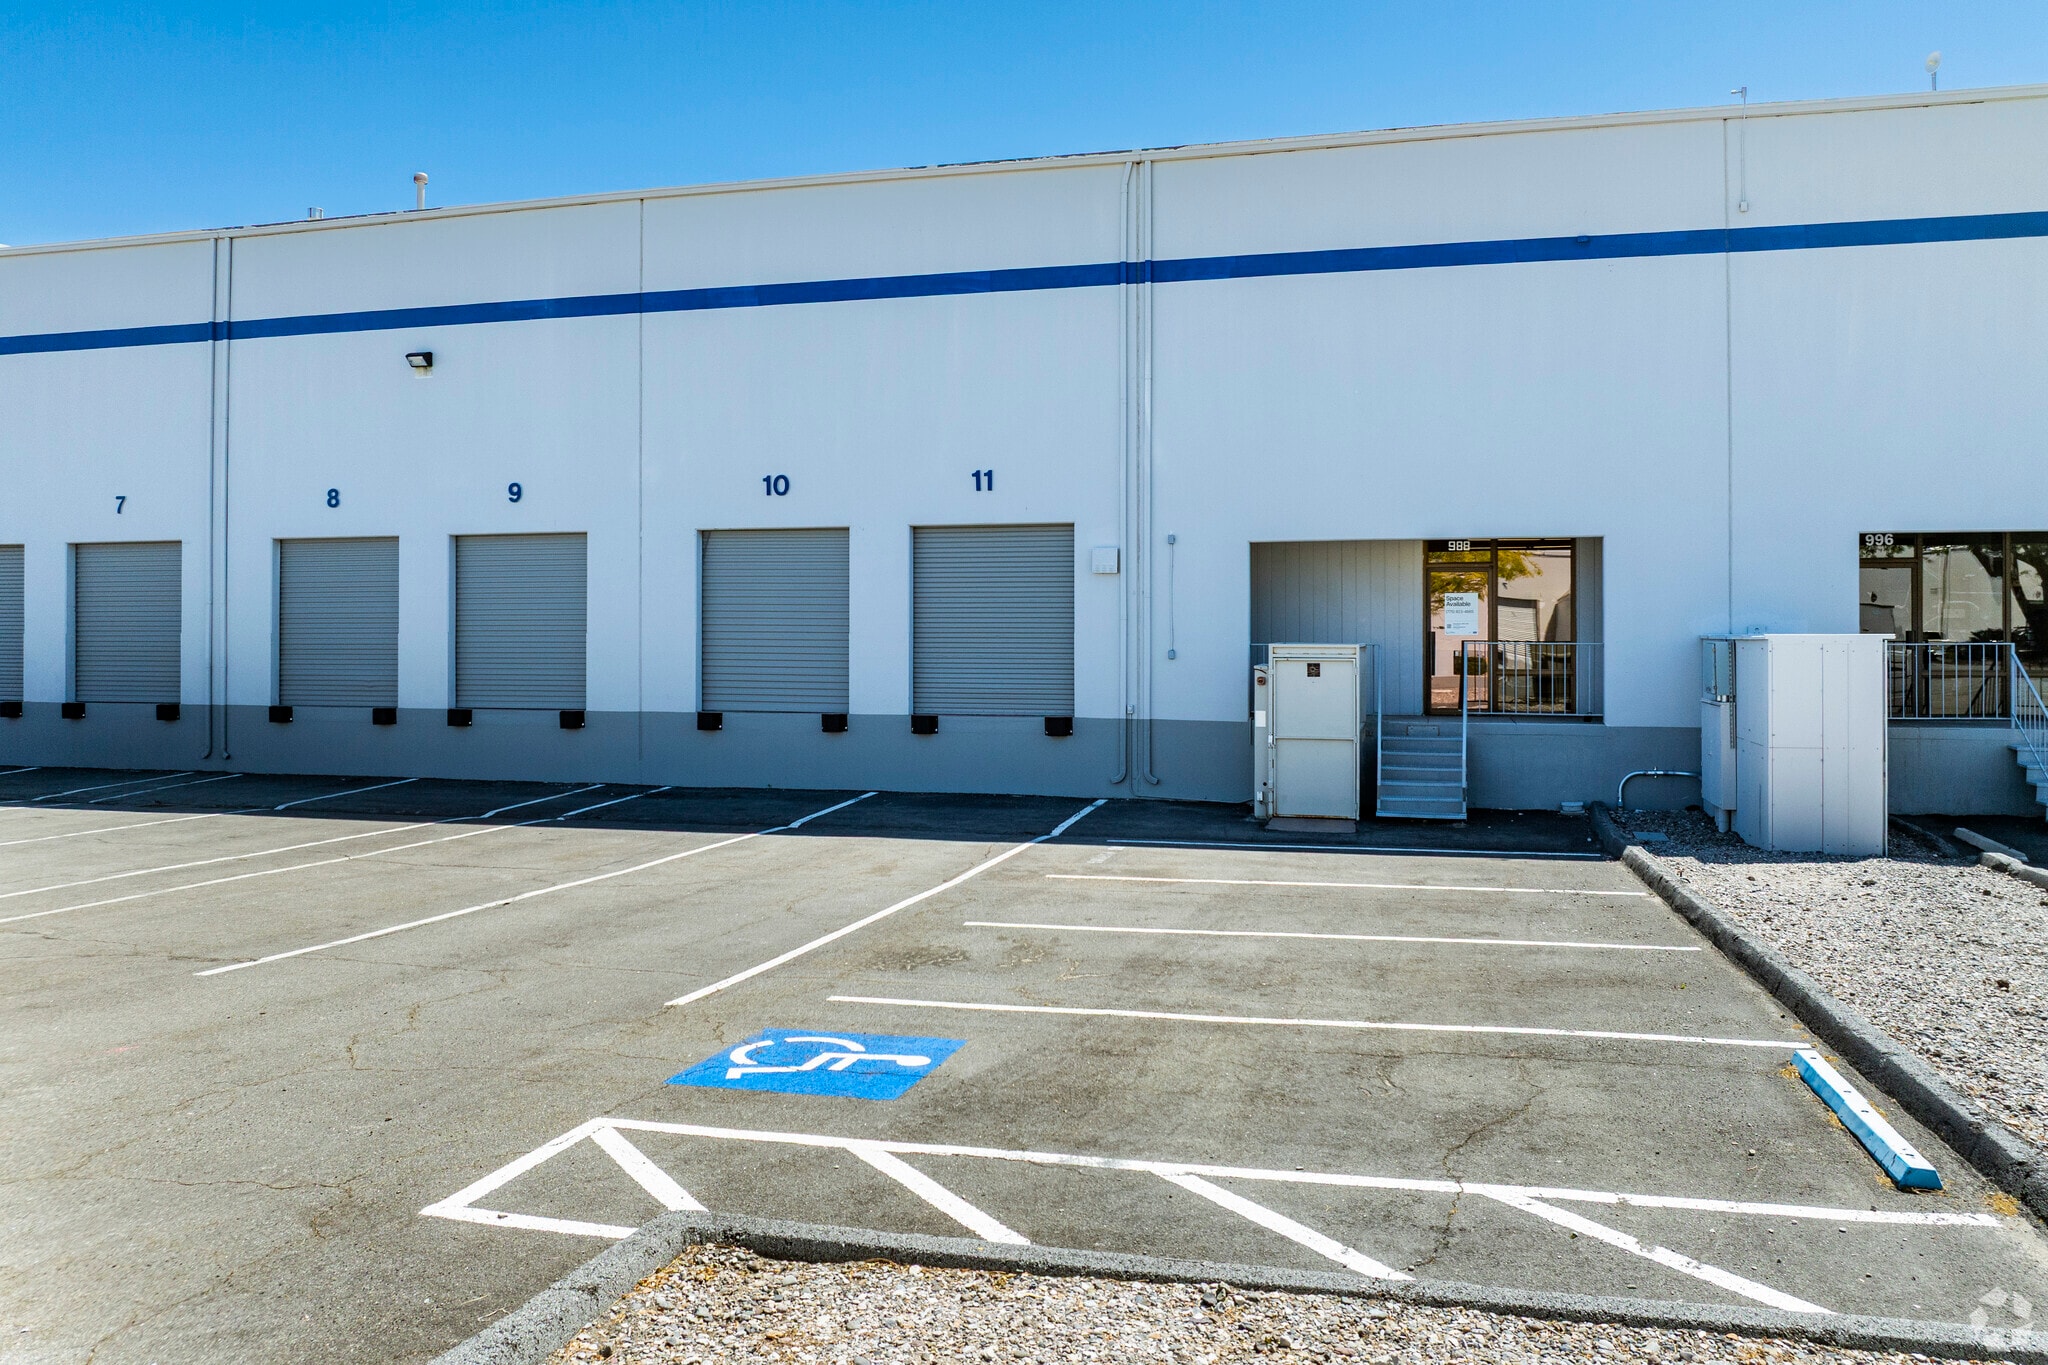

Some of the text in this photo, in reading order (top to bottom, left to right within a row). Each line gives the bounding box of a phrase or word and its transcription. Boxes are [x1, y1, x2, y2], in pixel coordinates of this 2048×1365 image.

[762, 474, 791, 497] 10
[971, 469, 993, 492] 11
[326, 488, 341, 509] 8
[507, 482, 523, 504] 9
[115, 495, 127, 515] 7
[1448, 540, 1471, 551] 988
[1865, 533, 1894, 546] 996
